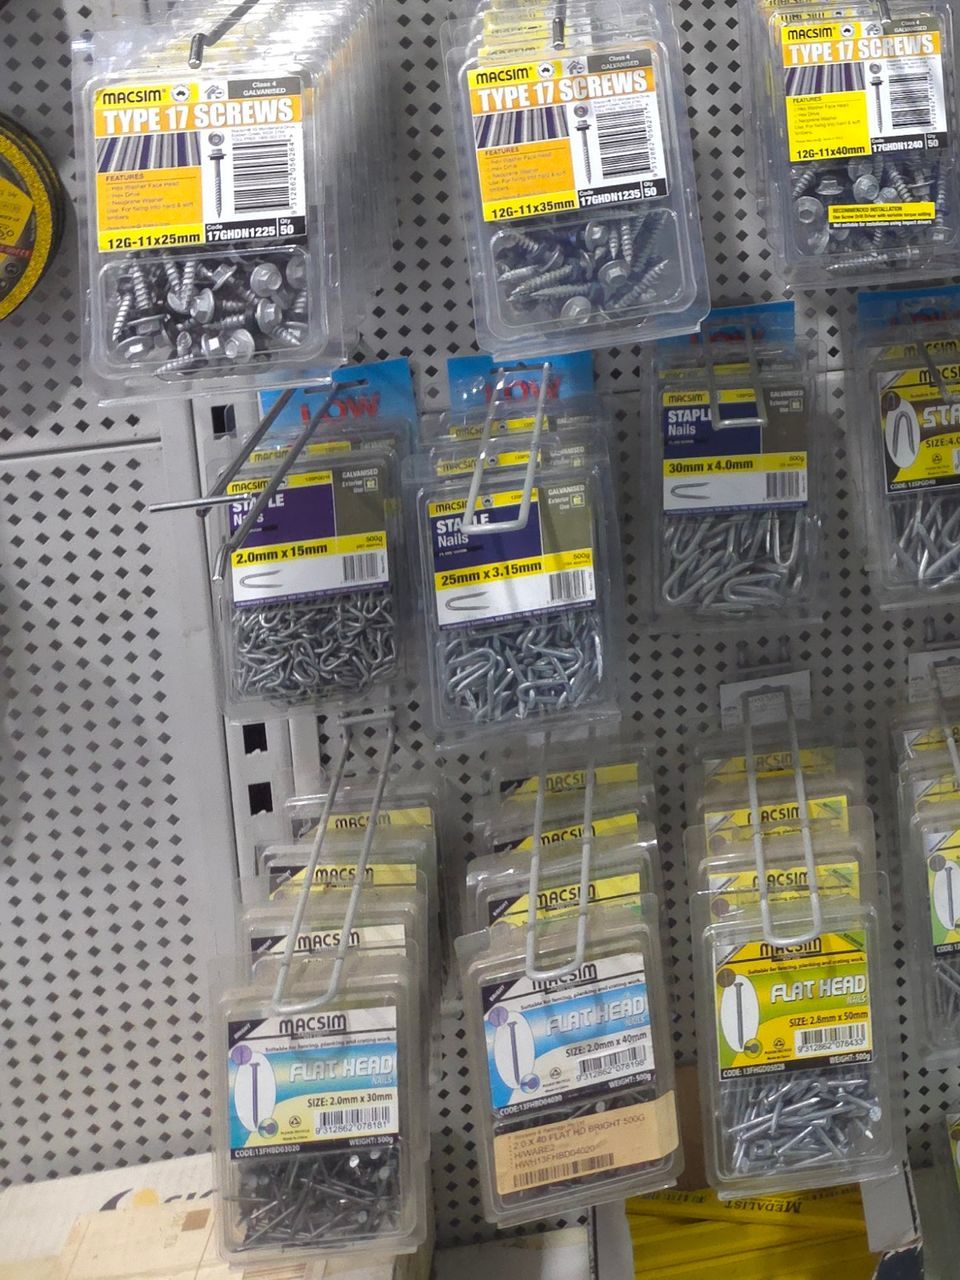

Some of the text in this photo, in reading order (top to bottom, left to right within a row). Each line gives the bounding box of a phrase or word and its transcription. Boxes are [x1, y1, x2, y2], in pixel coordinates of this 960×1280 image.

[788, 28, 832, 40] MACSIM
[789, 35, 934, 63] TYPE 17 SCREWS
[476, 68, 529, 84] MACSIM
[102, 90, 161, 104] MACSIM
[243, 87, 286, 96] GALVANISED
[478, 70, 647, 112] TYPE 17 SCREWS
[103, 98, 293, 133] TYPE 17 SCREWS
[928, 139, 938, 147] 50
[797, 145, 865, 159] 12G-11x40mm
[644, 187, 657, 197] 50
[491, 200, 575, 218] 12G-11x35mm
[207, 227, 275, 241] 17GHDN1225
[280, 225, 294, 234] 50
[108, 234, 200, 249] 12G-11x25mm
[668, 425, 695, 436] Nails
[669, 460, 753, 473] 30mm x 4.0mm
[438, 534, 469, 547] Nails
[236, 545, 328, 564] 2.0mm x 15mm
[441, 571, 480, 586] 25mm
[492, 562, 542, 577] 3.15mm
[489, 985, 505, 1001] BRIGHT
[770, 975, 866, 1003] FLAT HEAD
[546, 1009, 592, 1036] FLAT
[596, 996, 645, 1025] HEAD
[789, 1017, 808, 1027] SIZE:
[810, 1015, 836, 1025] 2.8mm
[844, 1011, 868, 1021] 50mm
[279, 1015, 347, 1034] MACSIM
[566, 1047, 585, 1057] SIZE:
[587, 1040, 614, 1053] 2.0mm
[622, 1032, 647, 1044] 40mm
[290, 1055, 392, 1082] FLAT HEAD
[307, 1098, 328, 1108] SIZE:
[330, 1095, 358, 1106] 2.0mm
[367, 1092, 392, 1102] 30mm
[725, 1200, 802, 1214] MEDALIST
